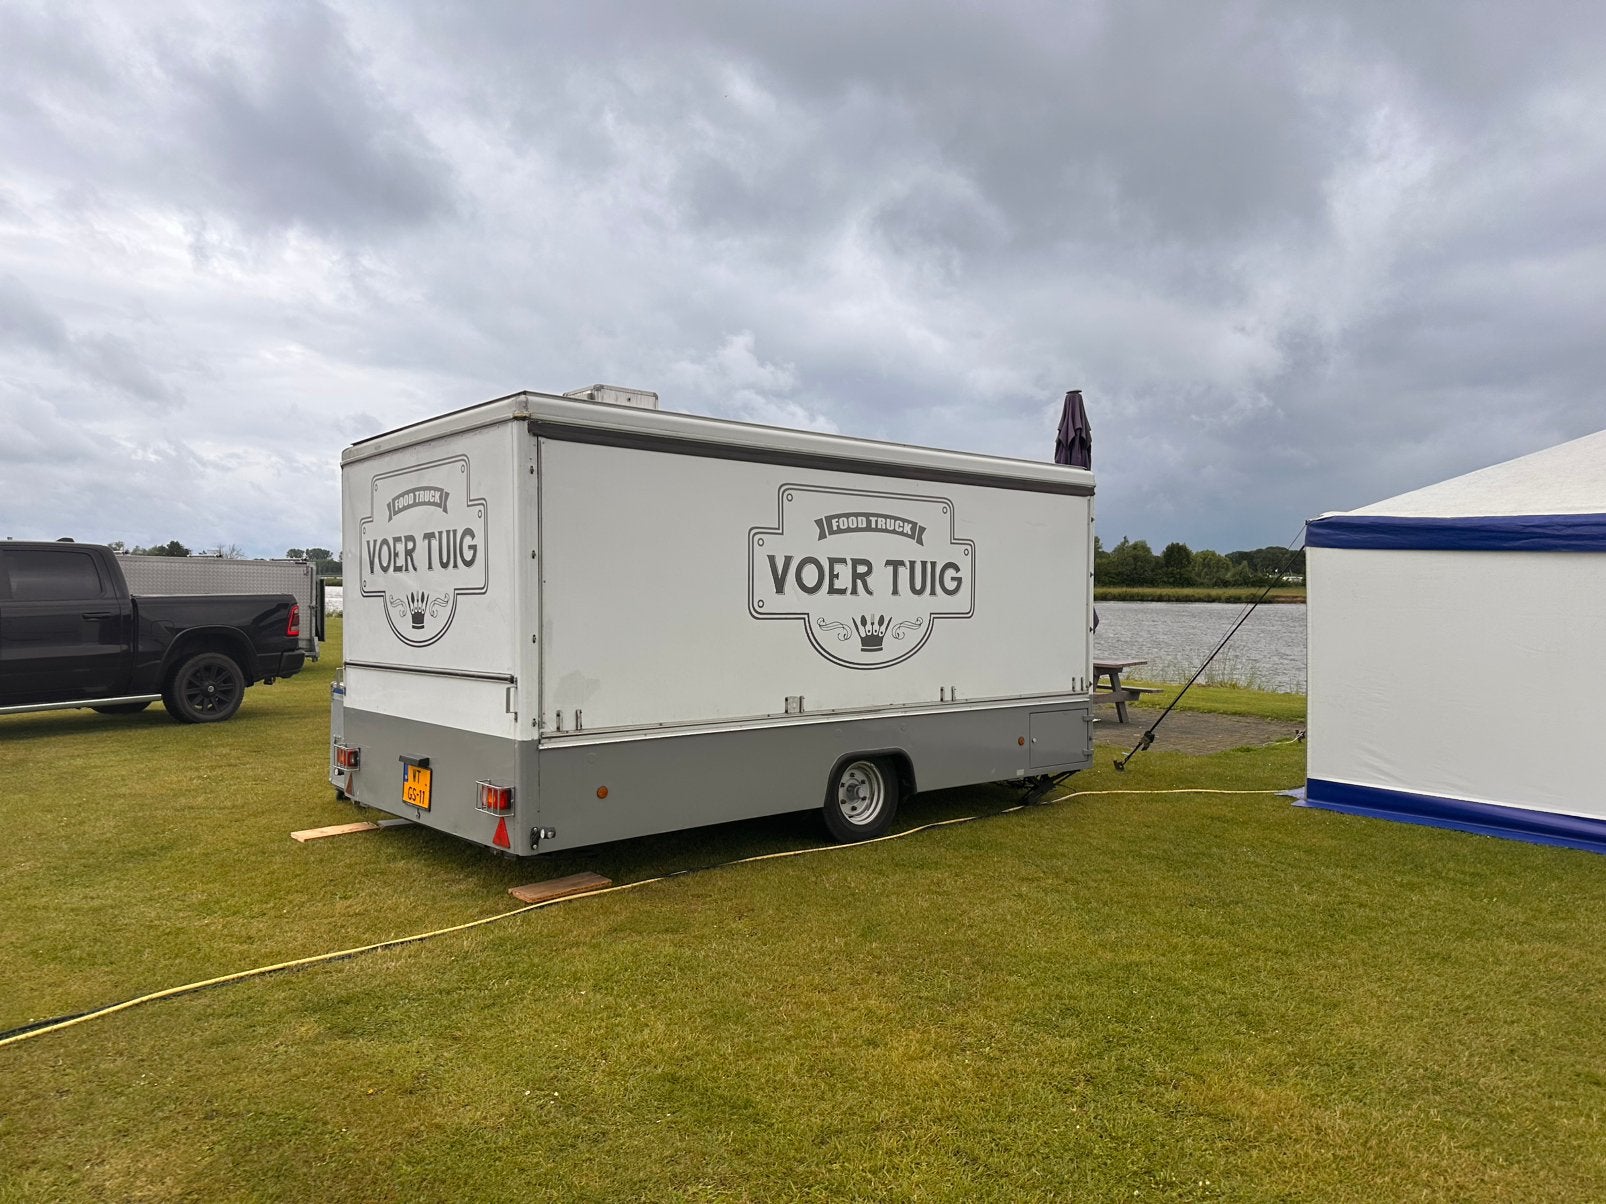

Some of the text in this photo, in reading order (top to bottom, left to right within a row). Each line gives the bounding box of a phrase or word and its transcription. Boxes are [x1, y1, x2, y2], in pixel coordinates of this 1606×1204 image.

[395, 490, 441, 511] FOOD TRUCK
[832, 516, 912, 535] FOOD TRUCK
[366, 527, 478, 574] VOER TUIG
[766, 554, 963, 596] VOER TUIG
